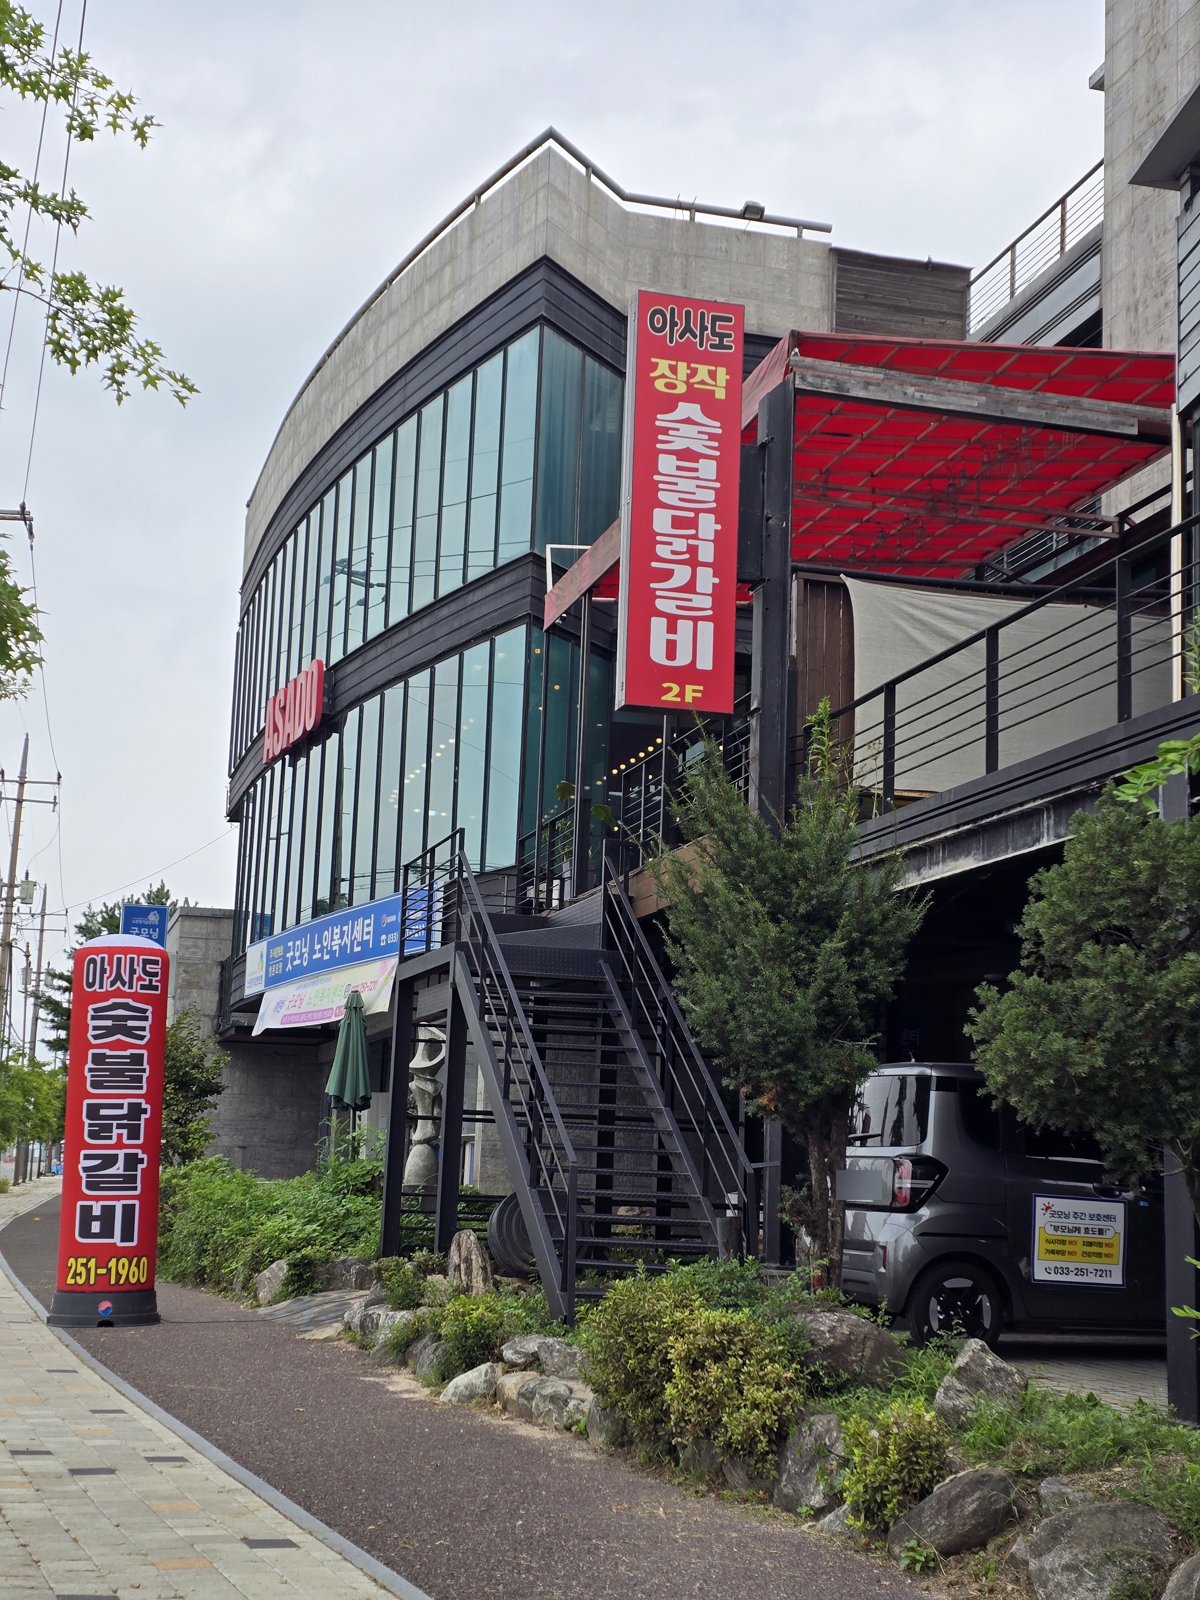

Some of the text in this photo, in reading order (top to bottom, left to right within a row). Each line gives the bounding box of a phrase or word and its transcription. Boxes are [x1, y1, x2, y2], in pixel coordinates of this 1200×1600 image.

[648, 304, 734, 352] 아사도
[650, 358, 730, 399] 장작
[649, 402, 722, 671] 숯불닭갈비
[263, 658, 324, 765] ASADO
[661, 682, 704, 703] 2F
[286, 913, 374, 972] 굿모닝 노인복지센터
[83, 953, 162, 995] 아사도
[75, 998, 152, 1247] 숯불닭갈비
[1049, 1209, 1117, 1223] 굿모닝 주간 보호센터
[66, 1256, 148, 1286] 251-1960
[1053, 1266, 1113, 1278] 033-251-7211
